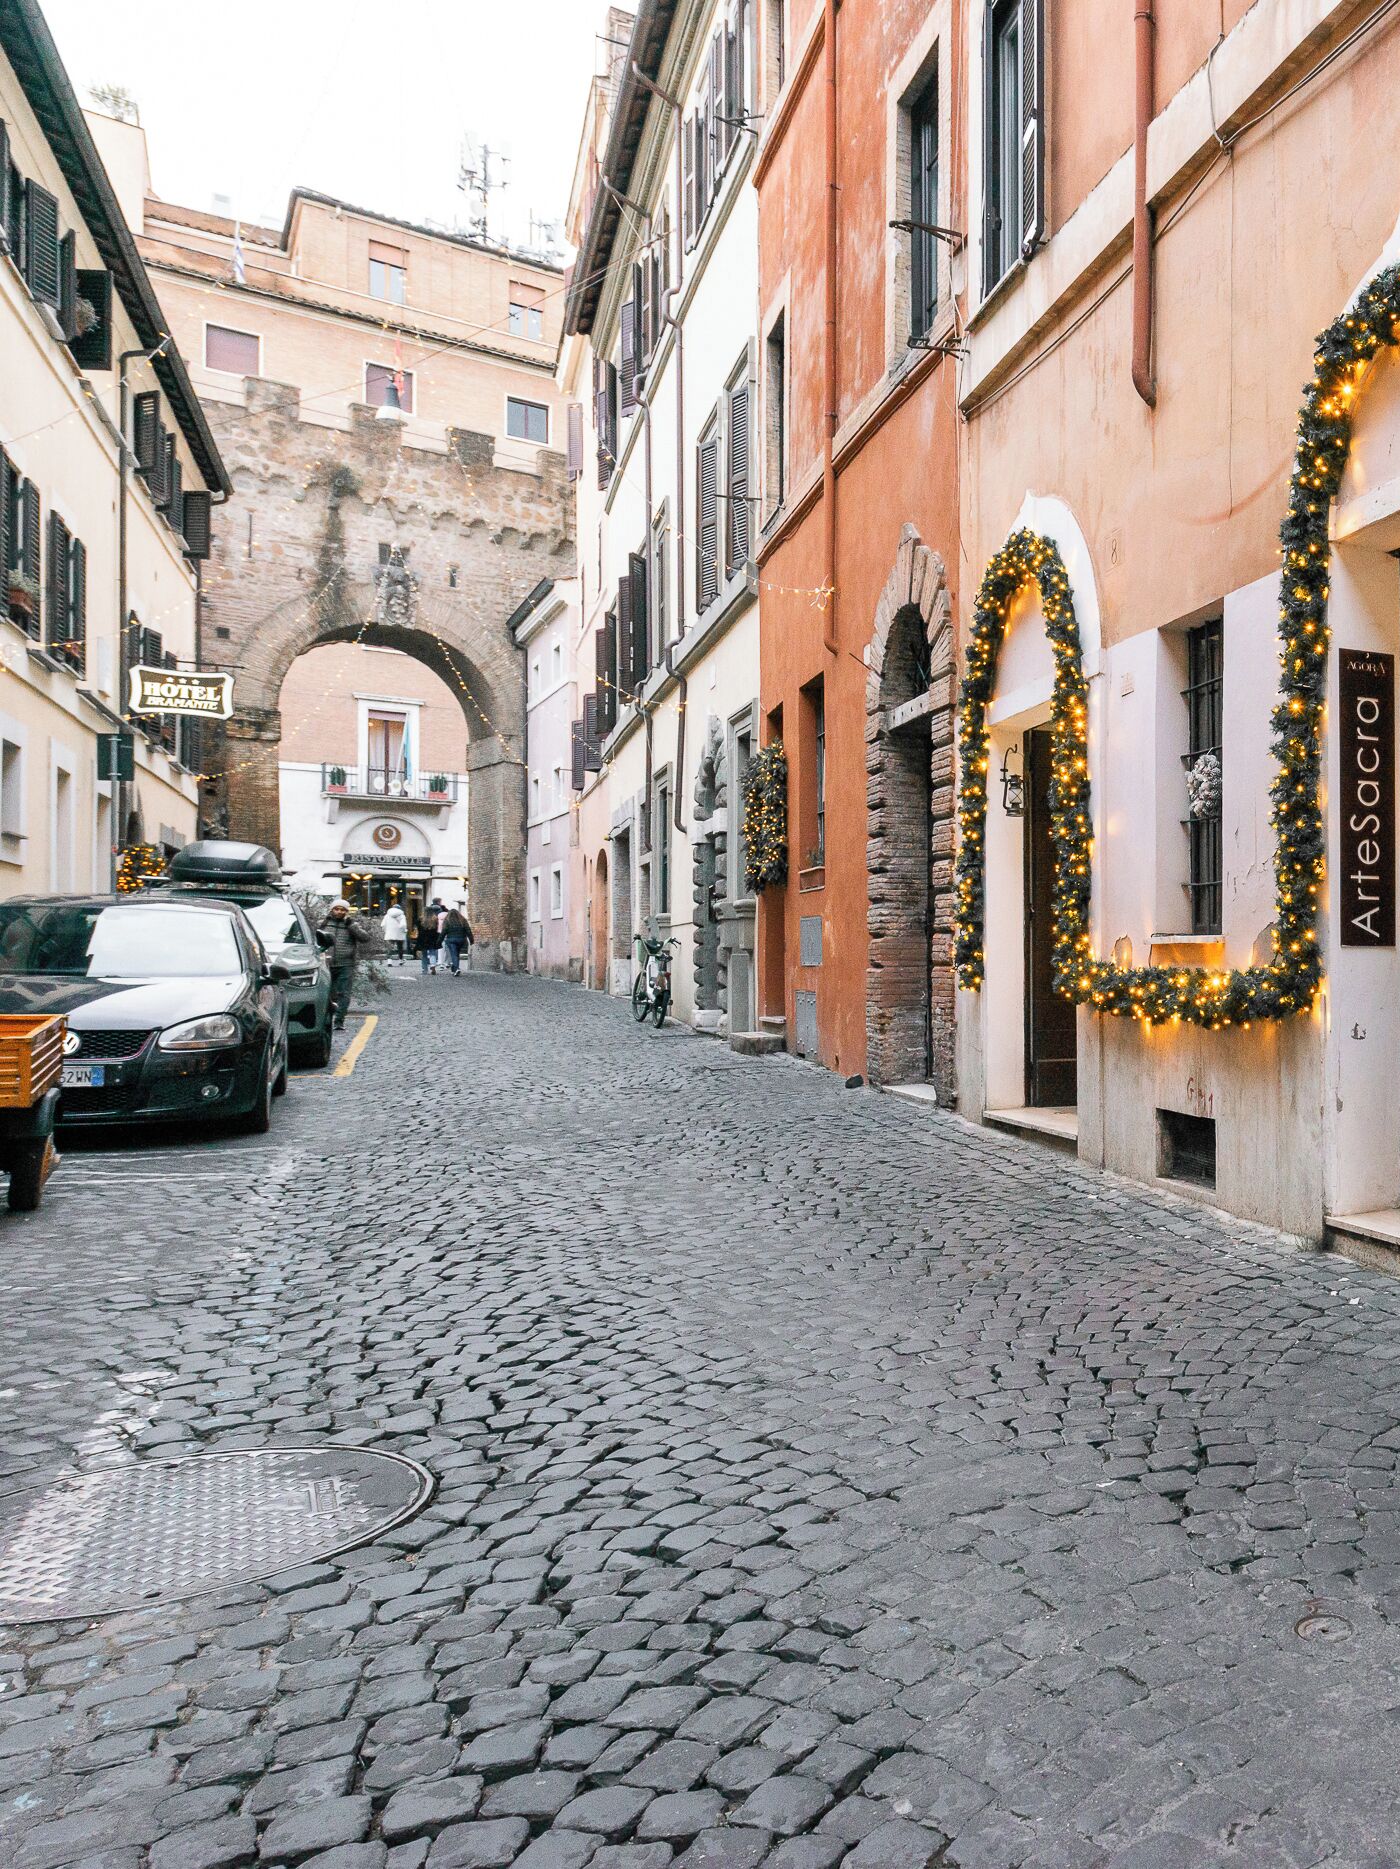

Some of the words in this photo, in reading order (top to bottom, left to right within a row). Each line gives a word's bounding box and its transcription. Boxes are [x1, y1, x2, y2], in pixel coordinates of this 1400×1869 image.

[1111, 538, 1118, 565] 8
[143, 681, 221, 701] HOTEL
[146, 696, 219, 710] BRAMANTE
[351, 854, 423, 864] RISTORANTE
